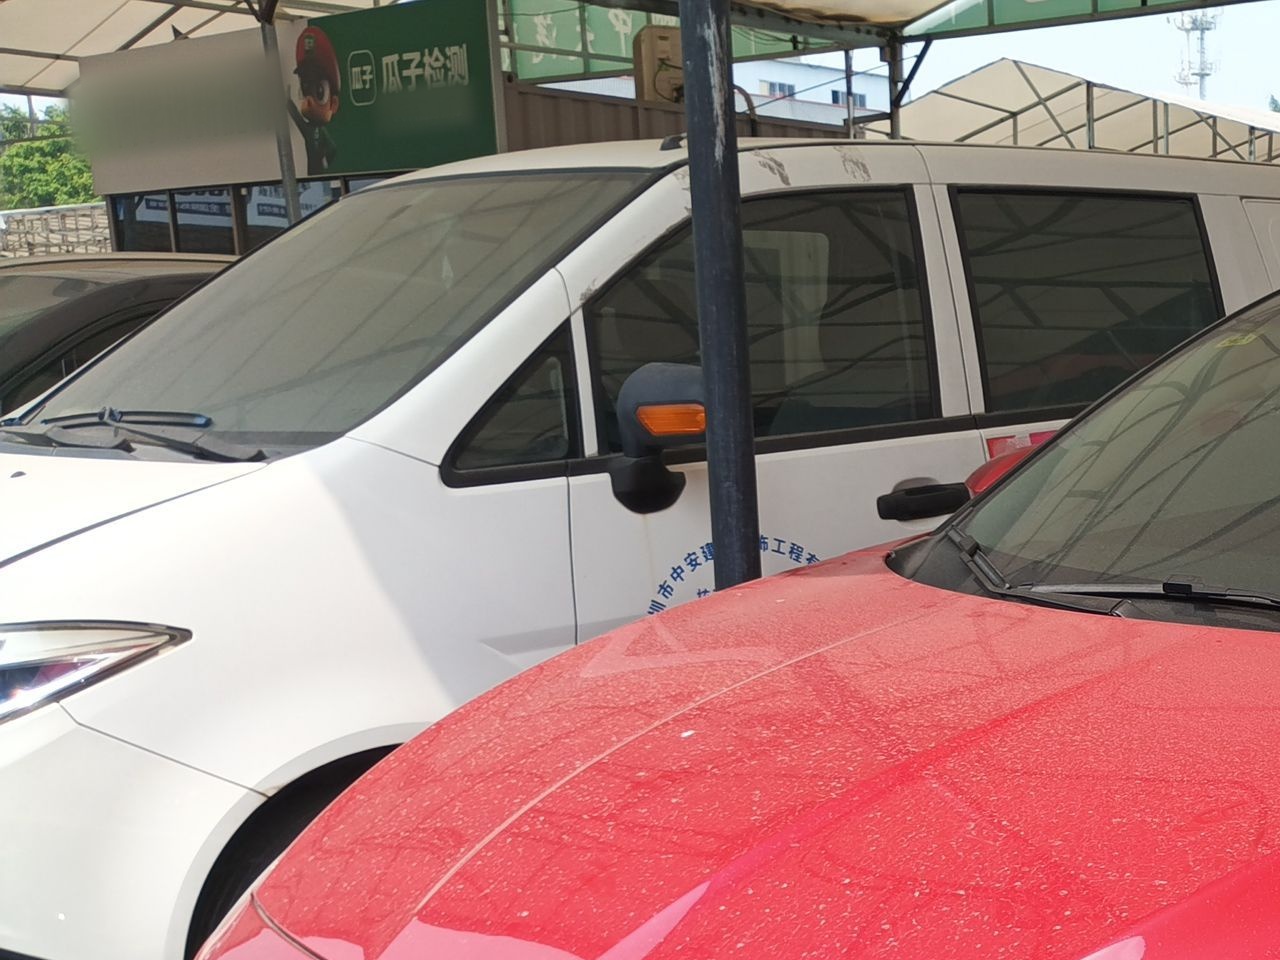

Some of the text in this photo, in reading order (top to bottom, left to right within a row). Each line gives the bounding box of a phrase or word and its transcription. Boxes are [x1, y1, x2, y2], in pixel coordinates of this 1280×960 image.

[352, 64, 374, 90] 瓜子
[381, 43, 470, 92] 瓜子检测
